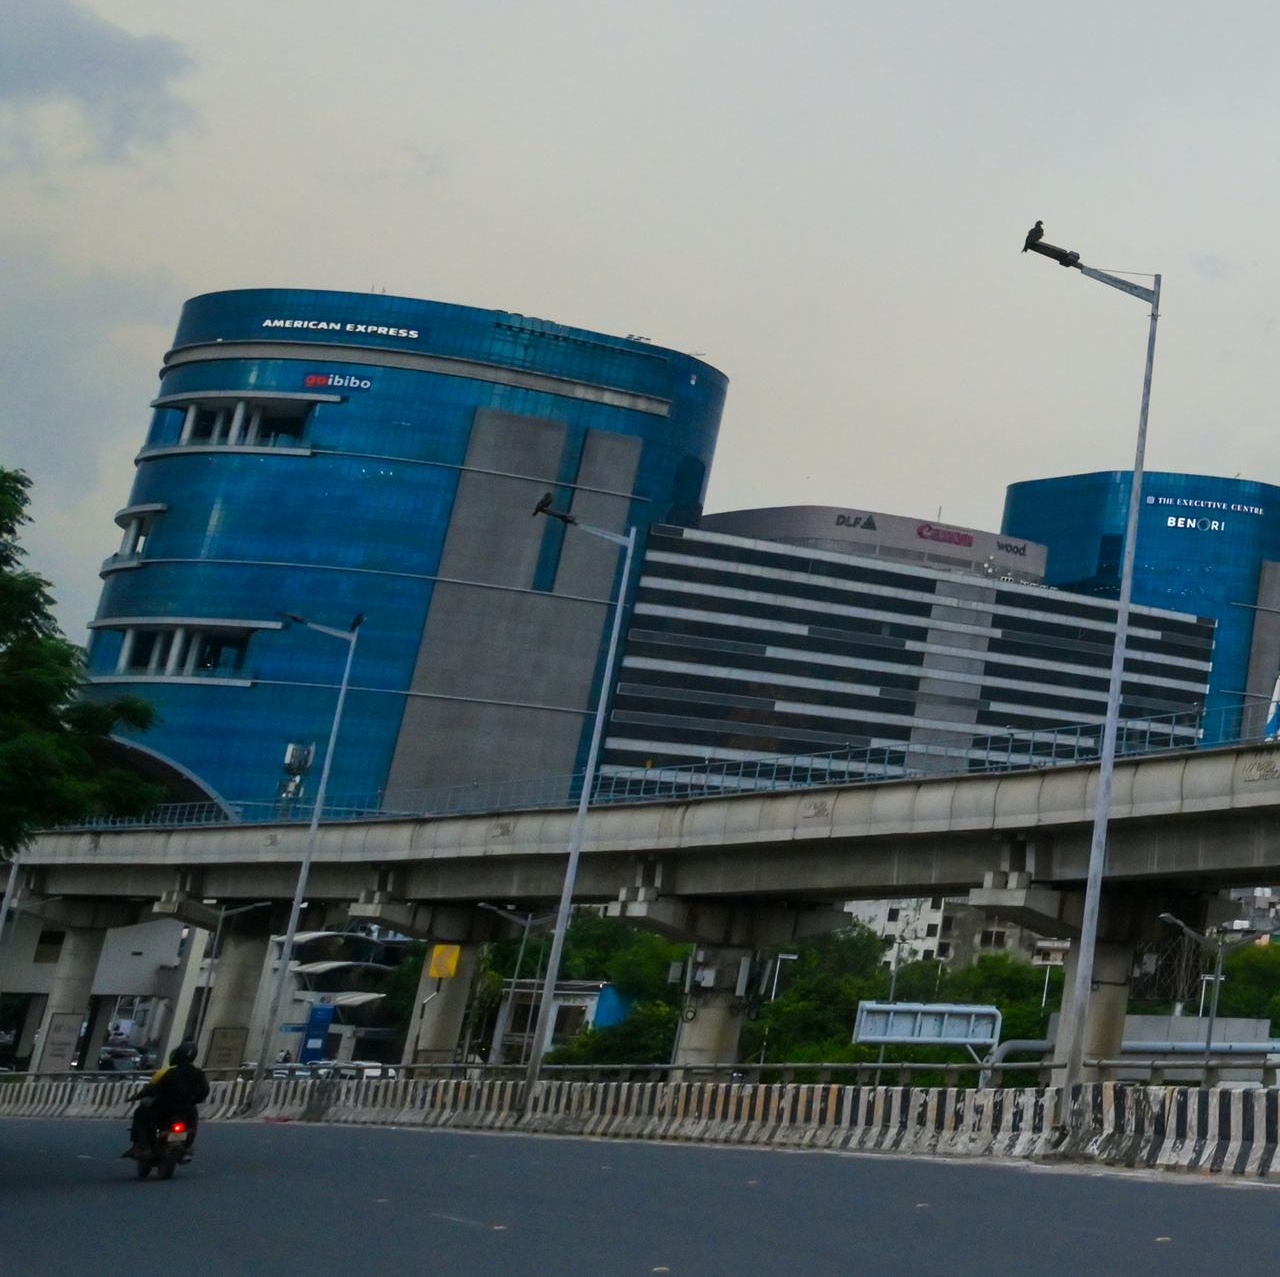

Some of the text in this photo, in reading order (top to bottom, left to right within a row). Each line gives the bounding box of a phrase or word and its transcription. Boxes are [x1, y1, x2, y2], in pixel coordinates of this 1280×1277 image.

[263, 319, 419, 338] AMERICAN EXPRESS
[306, 374, 370, 389] goibibo
[1157, 496, 1264, 515] THE EXECUTIVE CENTRE
[836, 514, 861, 527] DLF
[1167, 517, 1225, 531] BENORI
